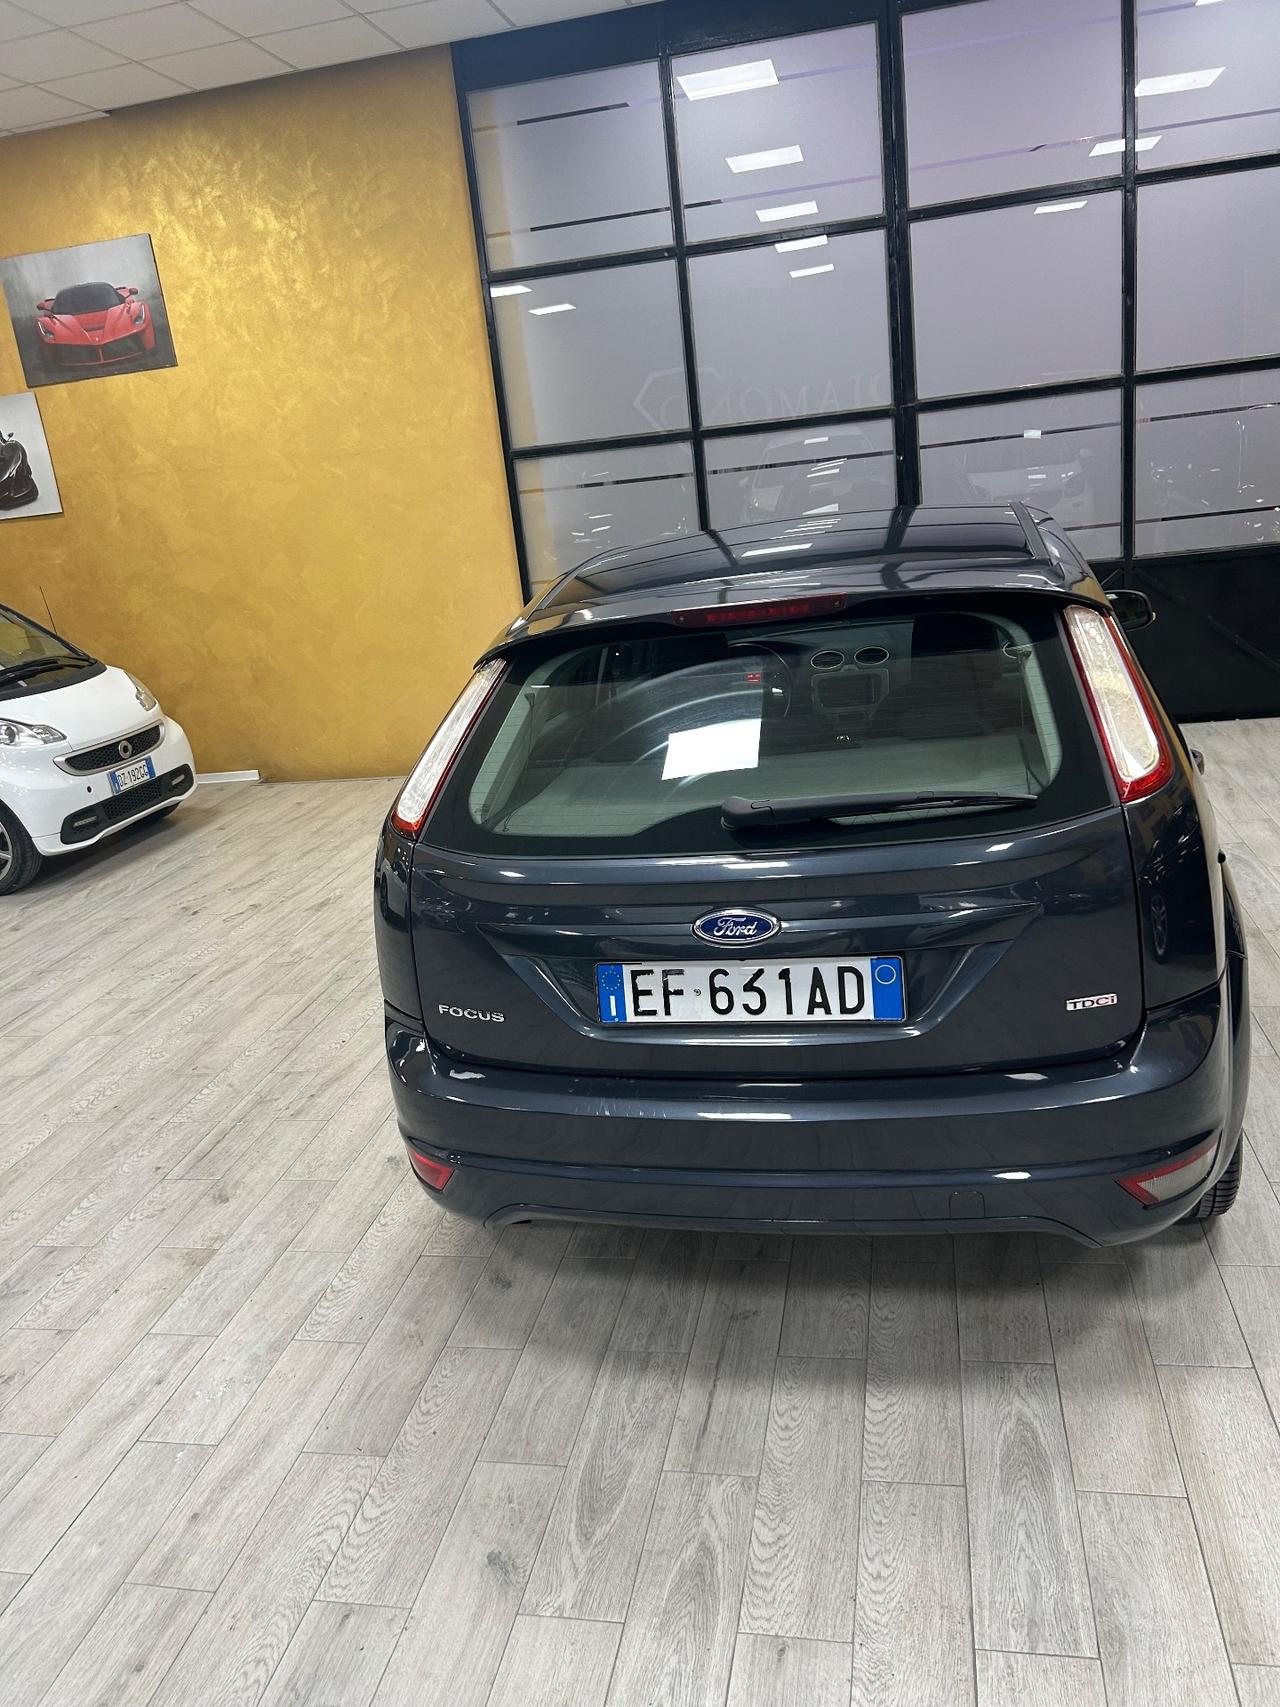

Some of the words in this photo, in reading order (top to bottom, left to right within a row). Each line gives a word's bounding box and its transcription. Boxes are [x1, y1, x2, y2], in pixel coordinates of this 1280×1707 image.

[713, 916, 759, 937] Ford
[630, 968, 685, 1016] EF
[708, 966, 866, 1016] 631AD
[1068, 995, 1115, 1009] TDCi
[438, 1004, 505, 1022] FOCUS
